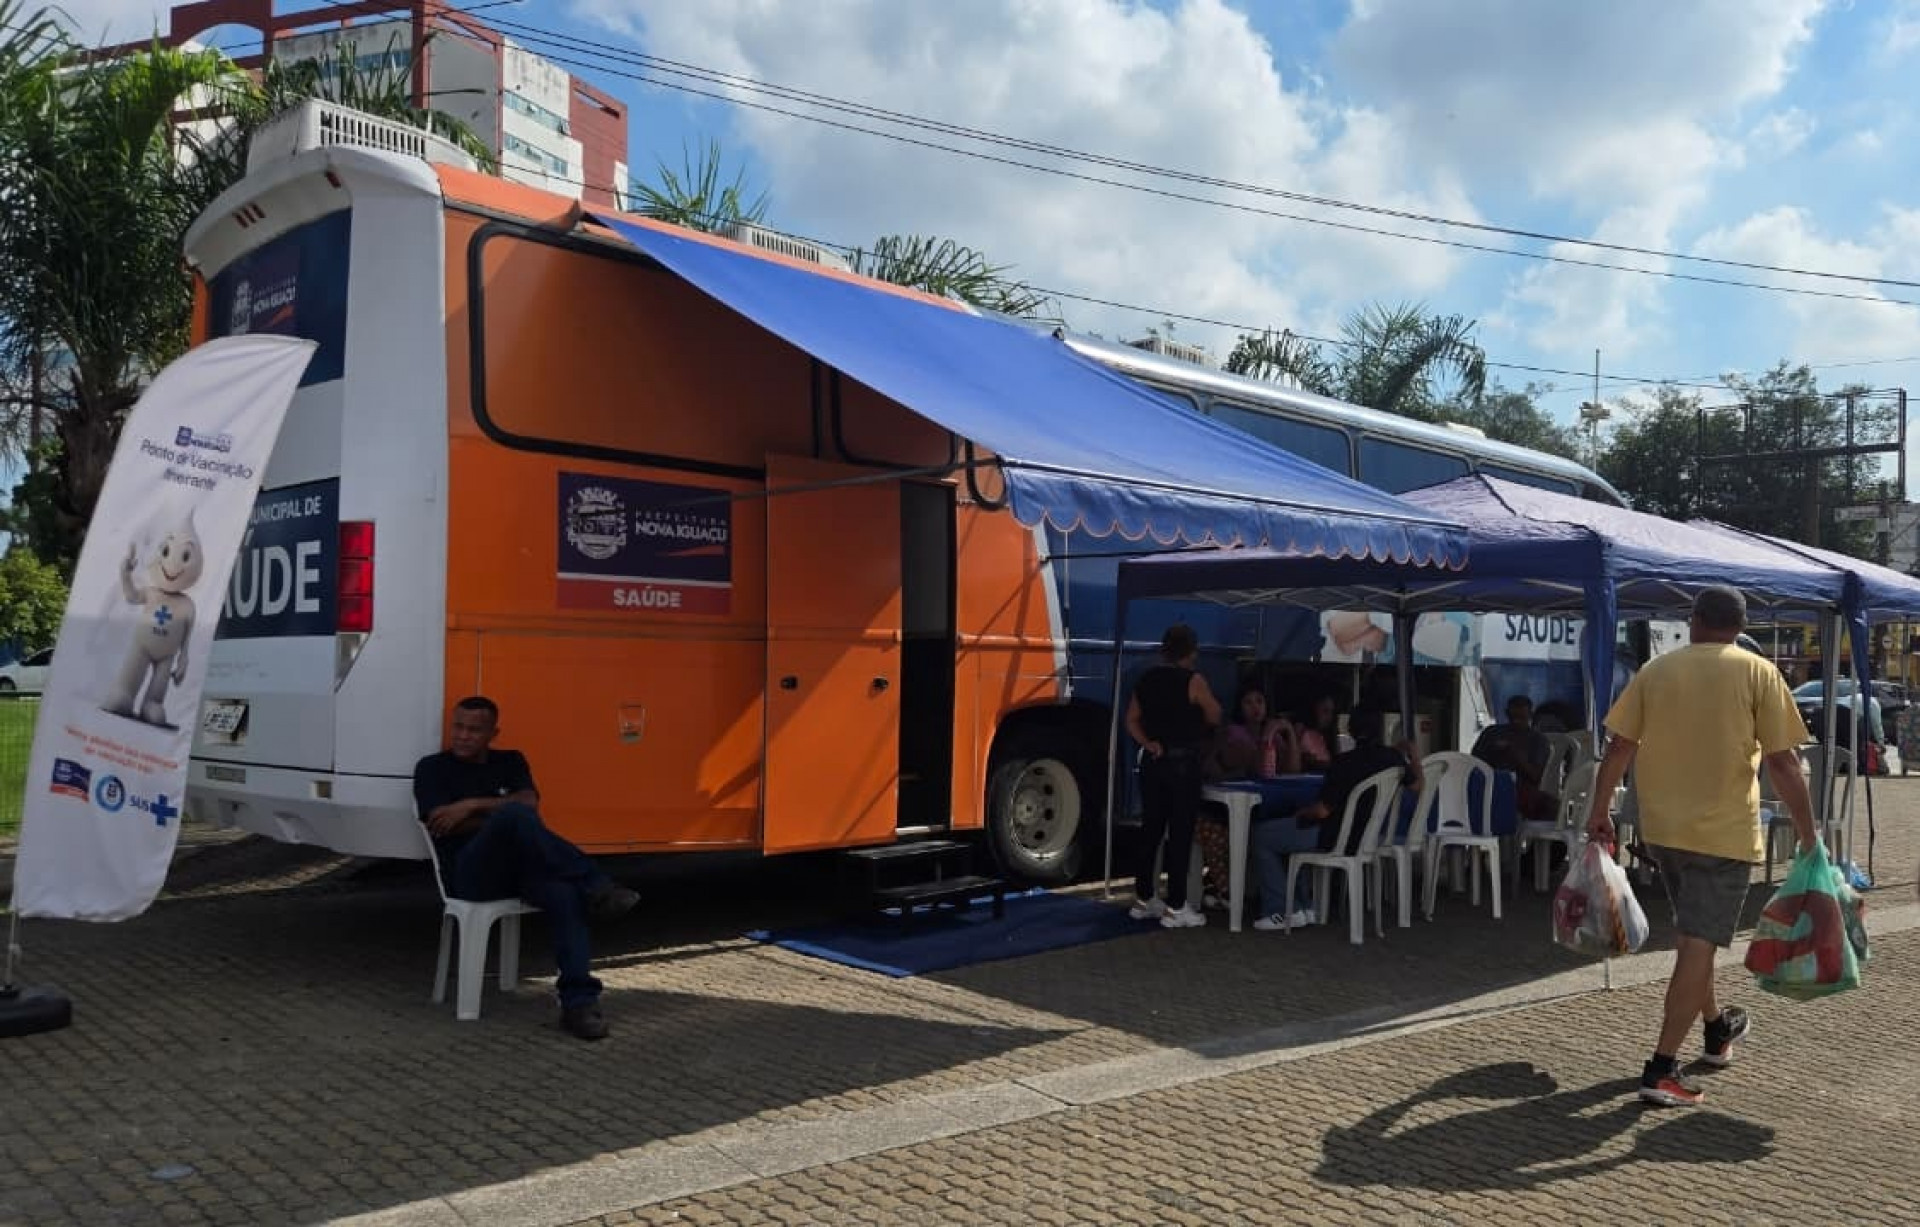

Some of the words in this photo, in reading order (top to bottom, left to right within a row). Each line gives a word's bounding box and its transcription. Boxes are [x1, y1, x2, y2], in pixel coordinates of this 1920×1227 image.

[304, 495, 322, 516] DE
[635, 521, 675, 539] NOVA
[676, 525, 728, 544] IGUAÇU
[224, 528, 322, 619] ÚDE
[613, 584, 683, 608] SAÚDE
